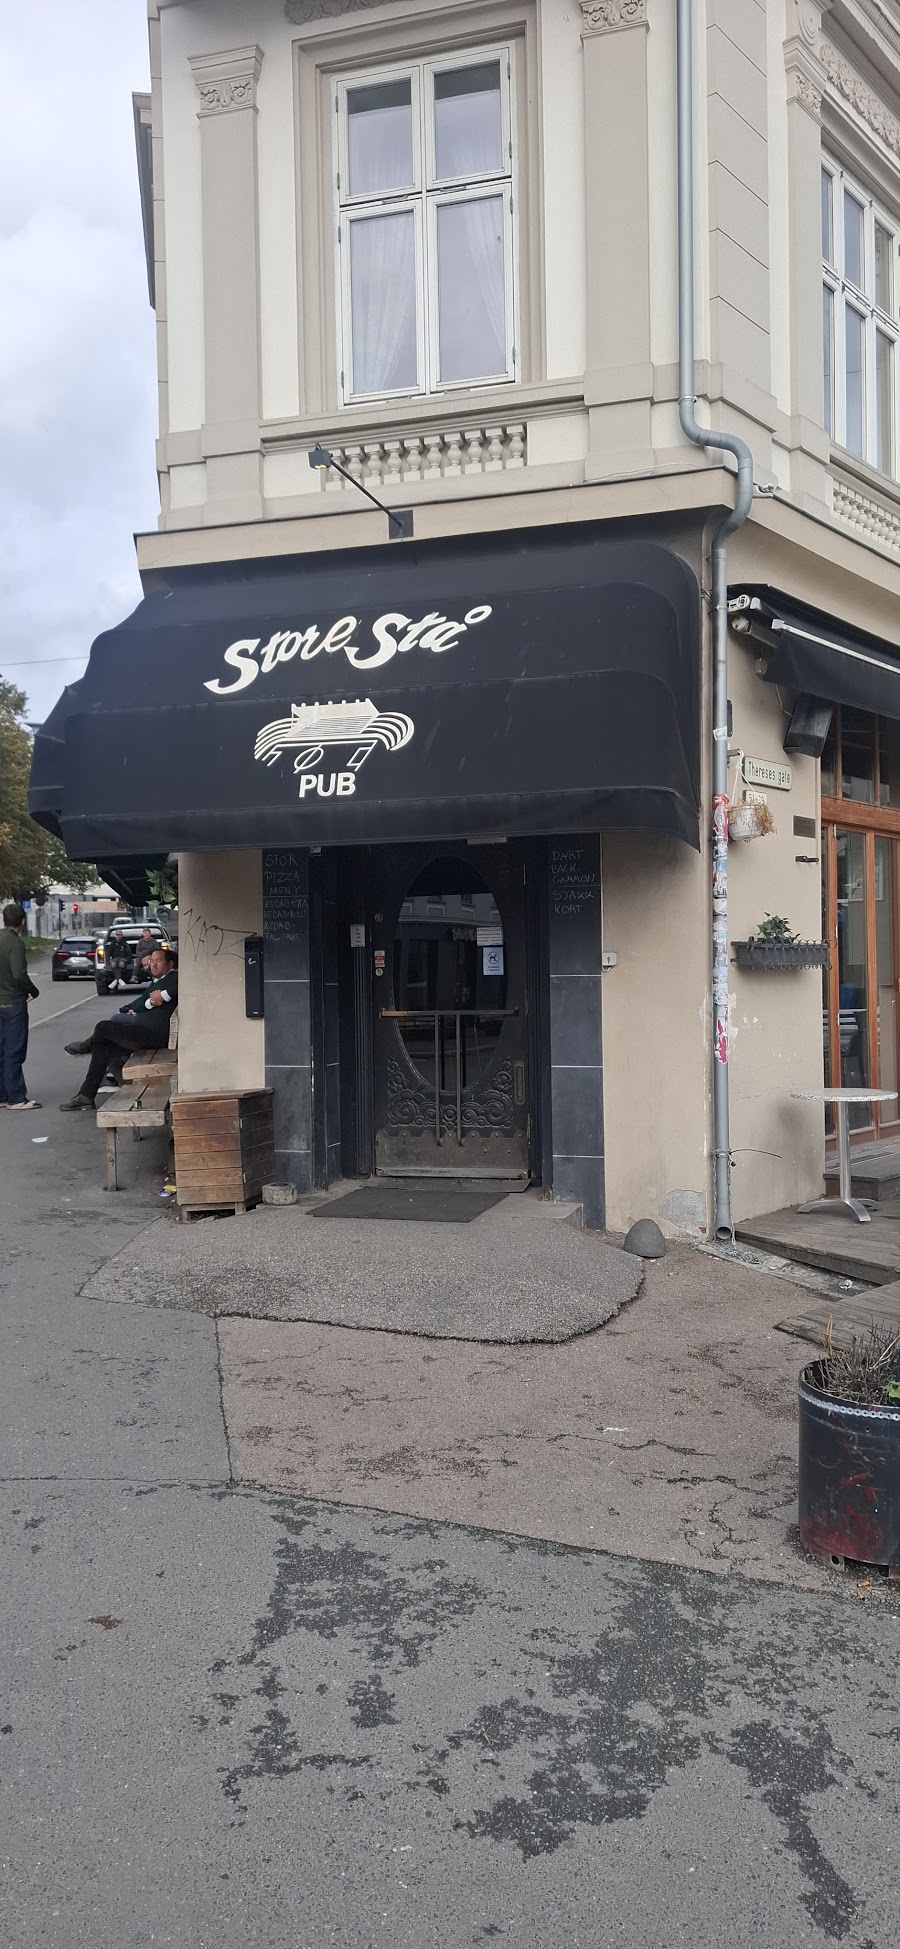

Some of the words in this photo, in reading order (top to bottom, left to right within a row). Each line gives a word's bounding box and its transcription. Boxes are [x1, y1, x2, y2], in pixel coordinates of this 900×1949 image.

[203, 616, 357, 694] Store
[748, 761, 776, 781] Thereses
[778, 770, 791, 785] gate
[299, 772, 356, 798] PUB
[265, 853, 297, 867] STOR
[552, 849, 585, 860] DART
[552, 873, 595, 884] GAMMON
[552, 889, 595, 900] SJAKK
[554, 904, 582, 914] KORT
